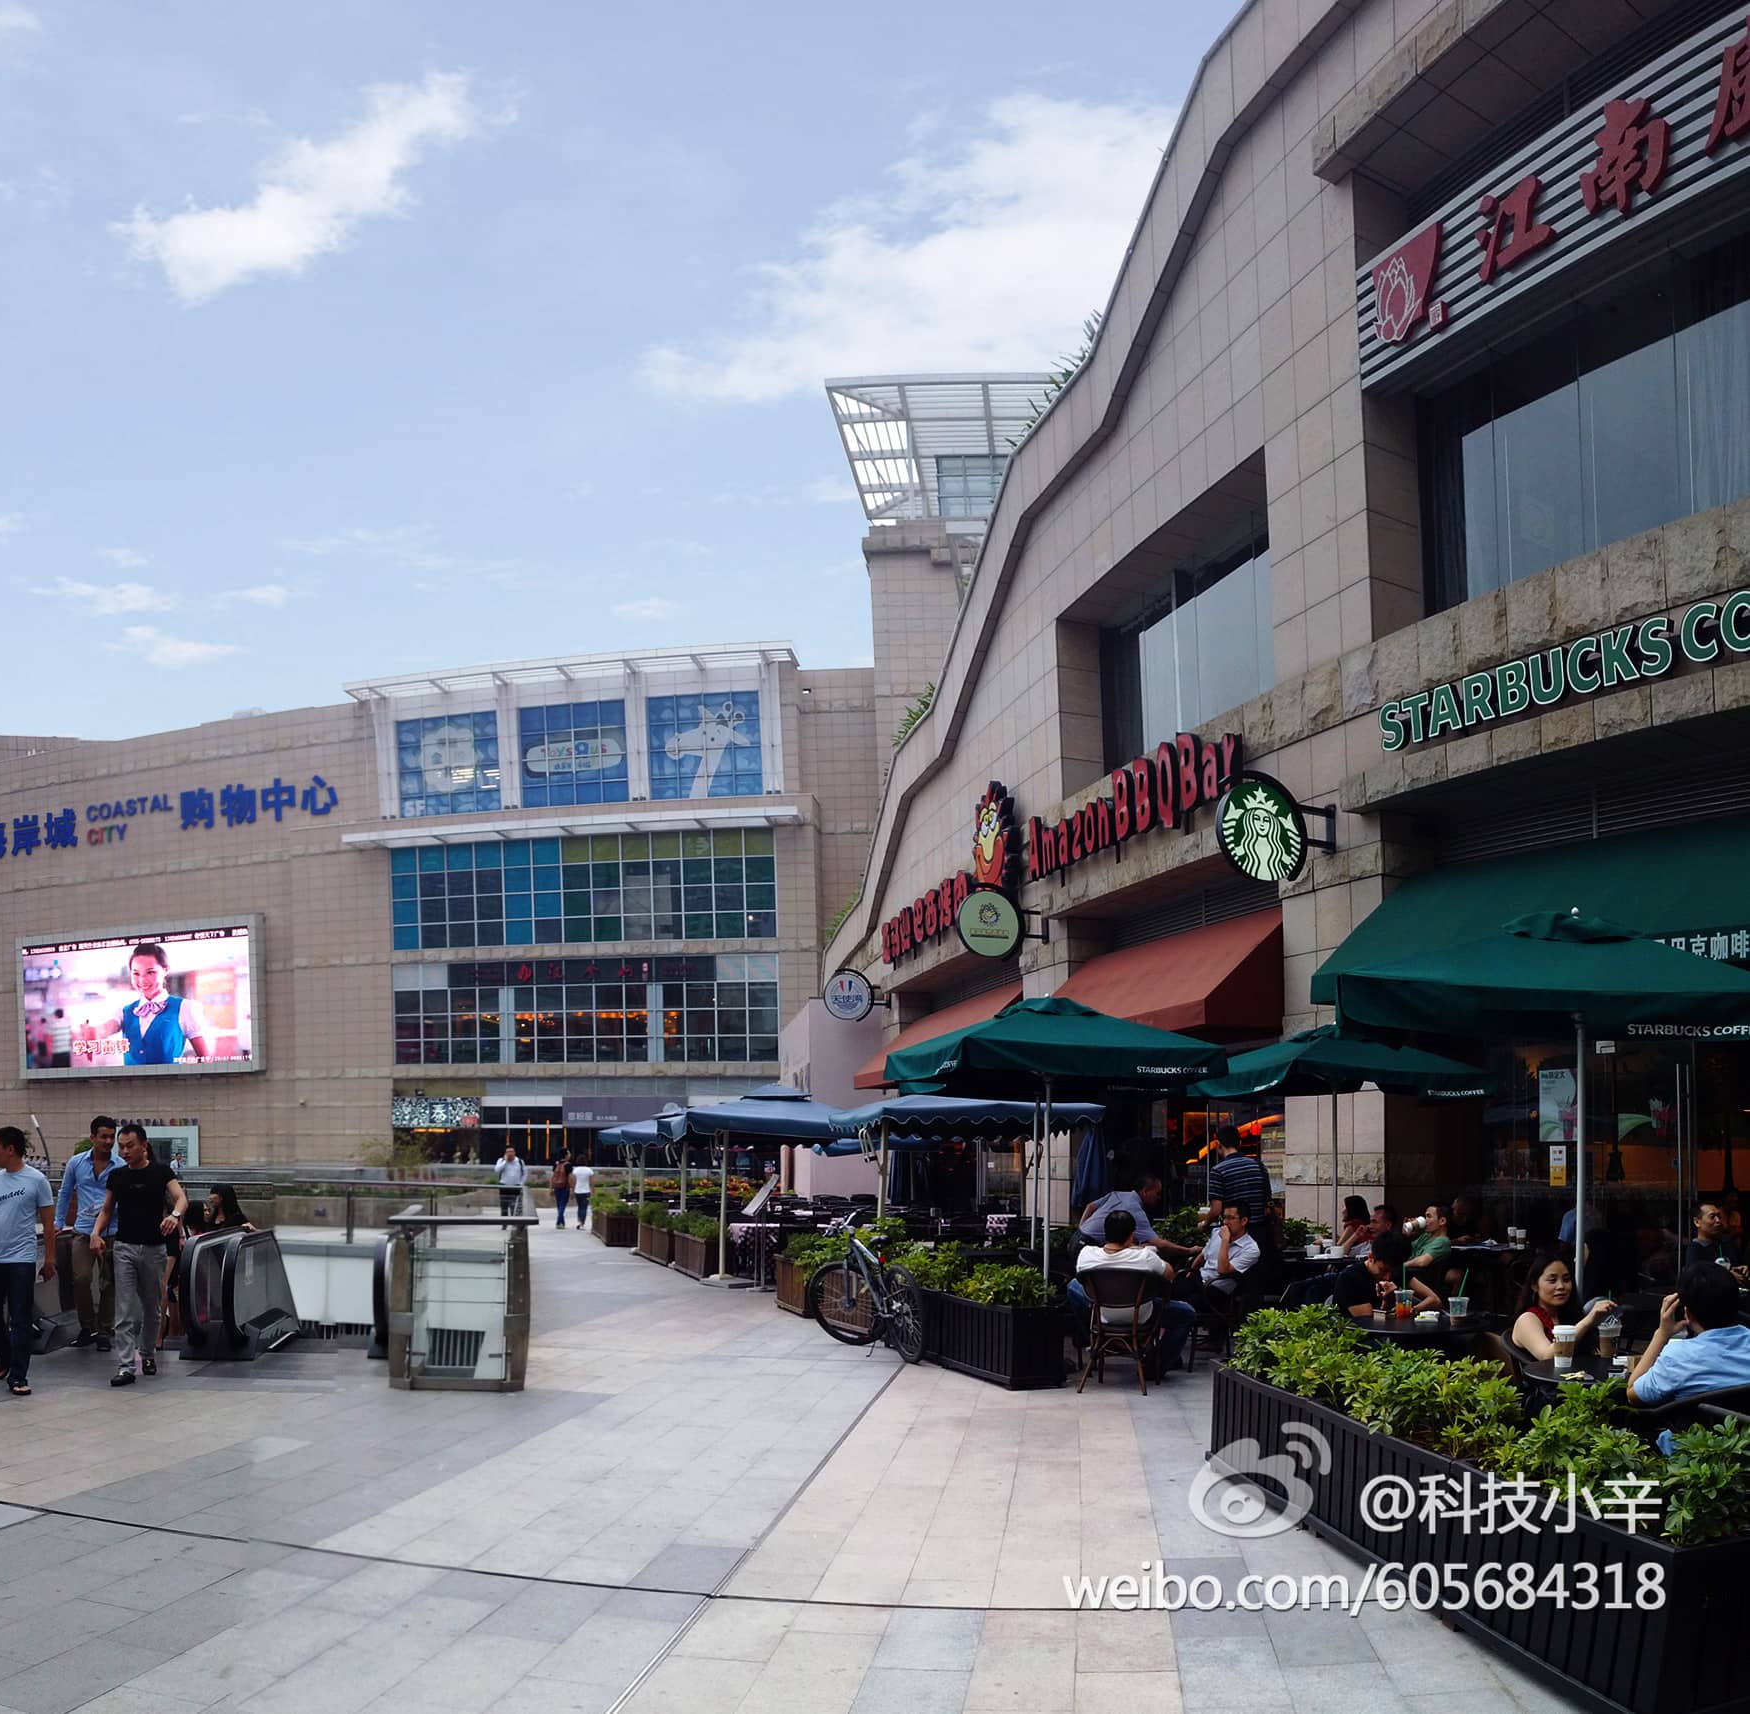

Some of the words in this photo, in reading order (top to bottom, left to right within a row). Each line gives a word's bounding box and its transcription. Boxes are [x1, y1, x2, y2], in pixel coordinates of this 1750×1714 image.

[1377, 614, 1672, 752] STARBUCKS
[86, 793, 174, 822] COASTAL
[179, 774, 339, 831] 购物中心
[86, 823, 127, 846] CITY
[1027, 797, 1110, 881] Amazon
[1652, 929, 1750, 961] 克咖啡
[1627, 1023, 1711, 1037] STARBUCKS
[1712, 1024, 1750, 1036] COFF
[1136, 1065, 1182, 1074] STARBUCKS
